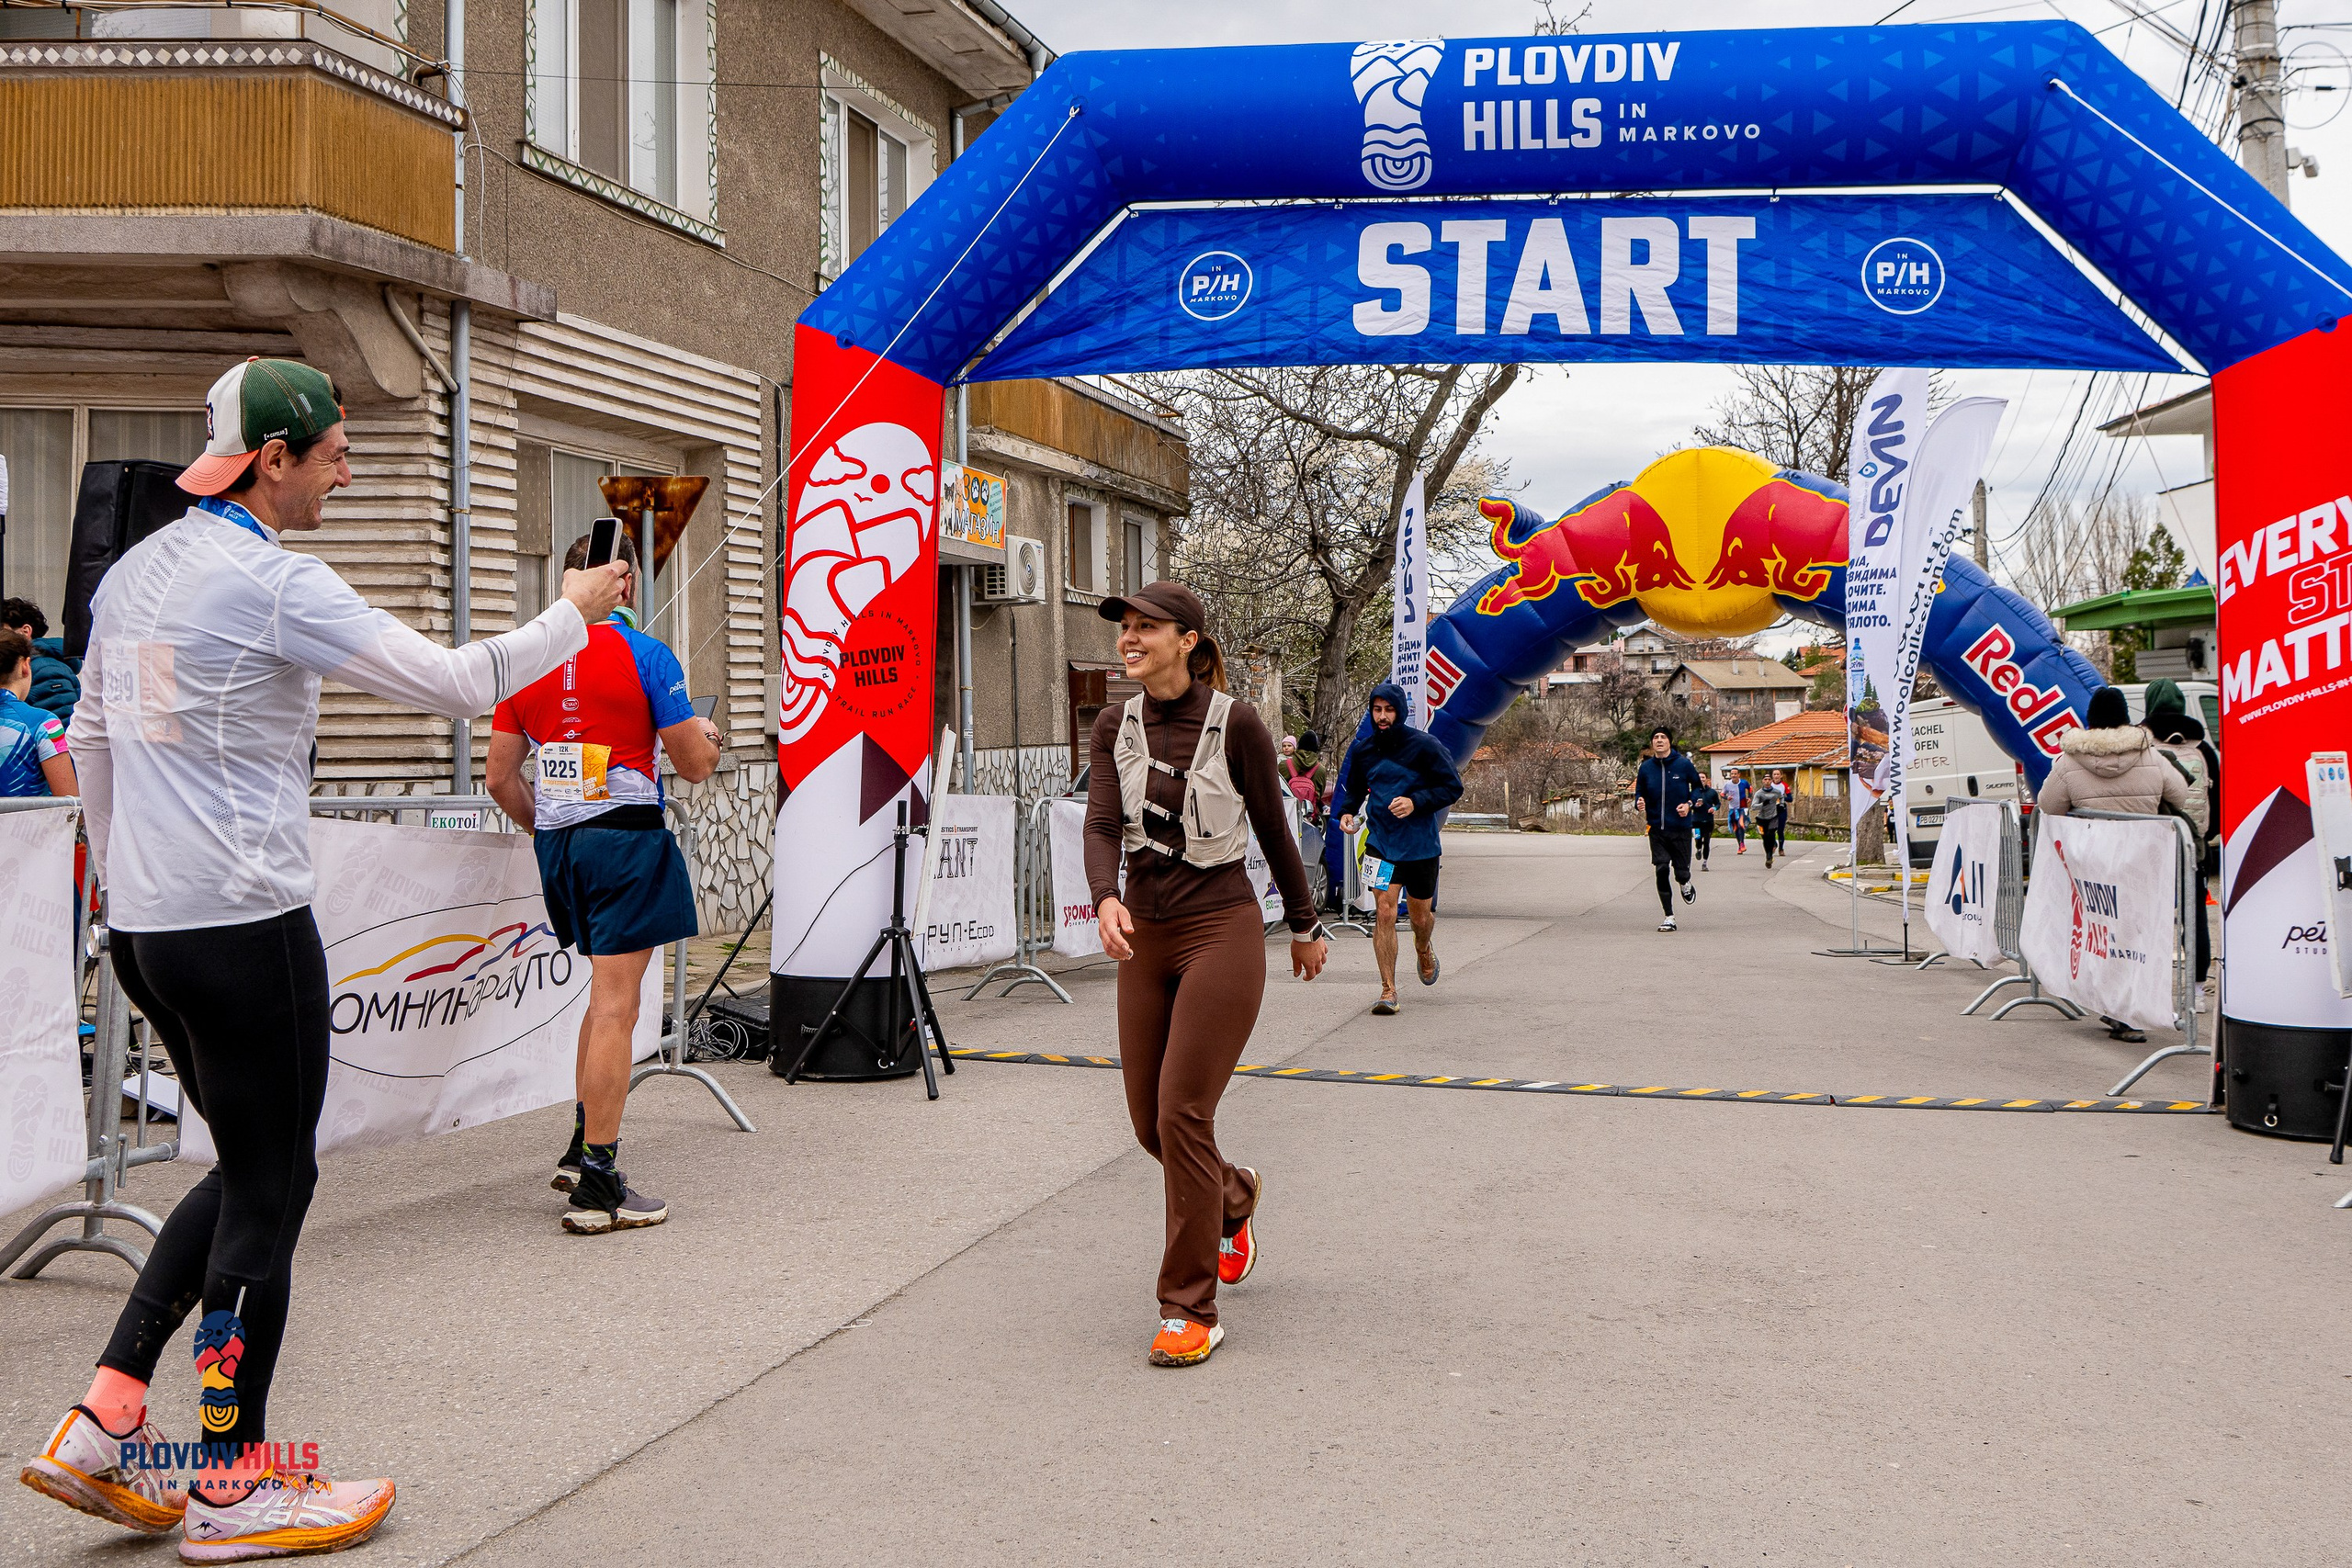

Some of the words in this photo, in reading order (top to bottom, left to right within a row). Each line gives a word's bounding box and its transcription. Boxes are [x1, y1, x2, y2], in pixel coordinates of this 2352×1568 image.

[1464, 41, 1681, 86] PLOVDIV
[1619, 103, 1646, 118] IN
[1463, 97, 1602, 152] HILLS
[1619, 123, 1761, 142] MARKOVO
[1192, 273, 1240, 297] P/H
[1352, 216, 1757, 337] START
[1876, 262, 1929, 287] P/H
[1189, 294, 1238, 303] MARKOVO
[1877, 288, 1929, 296] MARKOVO
[954, 508, 1001, 543] МАГАЗИН
[840, 645, 905, 669] PLOVDIV
[2222, 610, 2352, 716] MATT
[854, 667, 899, 687] HILLS
[1965, 627, 2062, 722] Red
[834, 695, 865, 717] TRAIL
[872, 709, 894, 718] RUN
[898, 686, 917, 711] RACE
[2238, 675, 2352, 725] WWW.PLOVDIV-HILLS-IN-
[1914, 739, 1939, 751] ÖFEN
[542, 760, 577, 778] 1225
